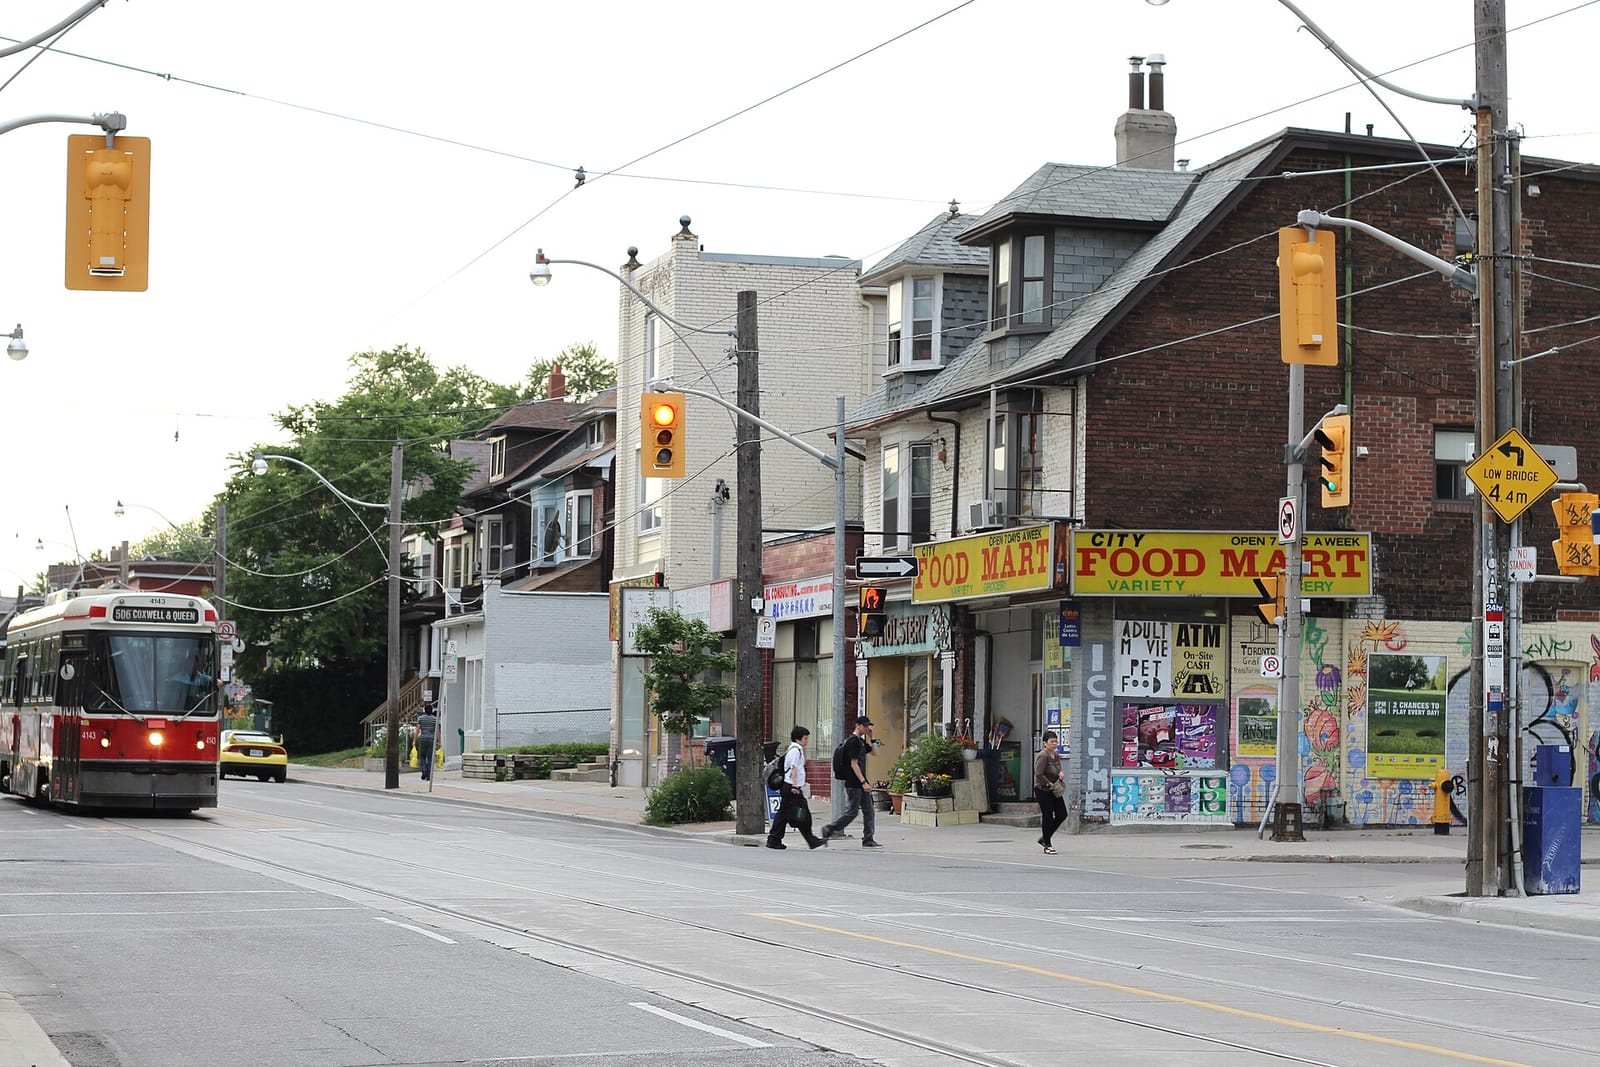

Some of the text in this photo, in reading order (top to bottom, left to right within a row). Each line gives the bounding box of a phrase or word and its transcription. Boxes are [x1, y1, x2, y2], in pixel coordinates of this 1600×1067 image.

[1484, 469, 1539, 482] LOW BRIDGE
[988, 535, 1003, 547] OPEN
[1007, 532, 1021, 544] DAYS
[1027, 529, 1043, 540] WEEK
[1091, 532, 1145, 547] CITY
[1231, 536, 1265, 545] OPEN
[1270, 537, 1276, 545] 7
[1314, 538, 1322, 546] A
[1326, 538, 1360, 546] WEEK
[921, 544, 936, 556] CITY
[1517, 550, 1528, 559] NO
[915, 538, 1049, 589] FOOD MART
[1076, 548, 1365, 577] FOOD MART
[1509, 560, 1535, 571] STANDING
[1107, 580, 1186, 591] VARIETY
[1486, 604, 1504, 612] 24hr
[132, 610, 165, 620] COXWELL
[165, 611, 172, 619] &
[172, 611, 196, 621] QUEEN
[1123, 621, 1168, 639] ADULT
[1176, 624, 1221, 648] ATM
[1183, 652, 1213, 660] On-Site
[1240, 644, 1276, 656] TORONTO
[1131, 659, 1162, 677] PET
[81, 731, 97, 740] 4143
